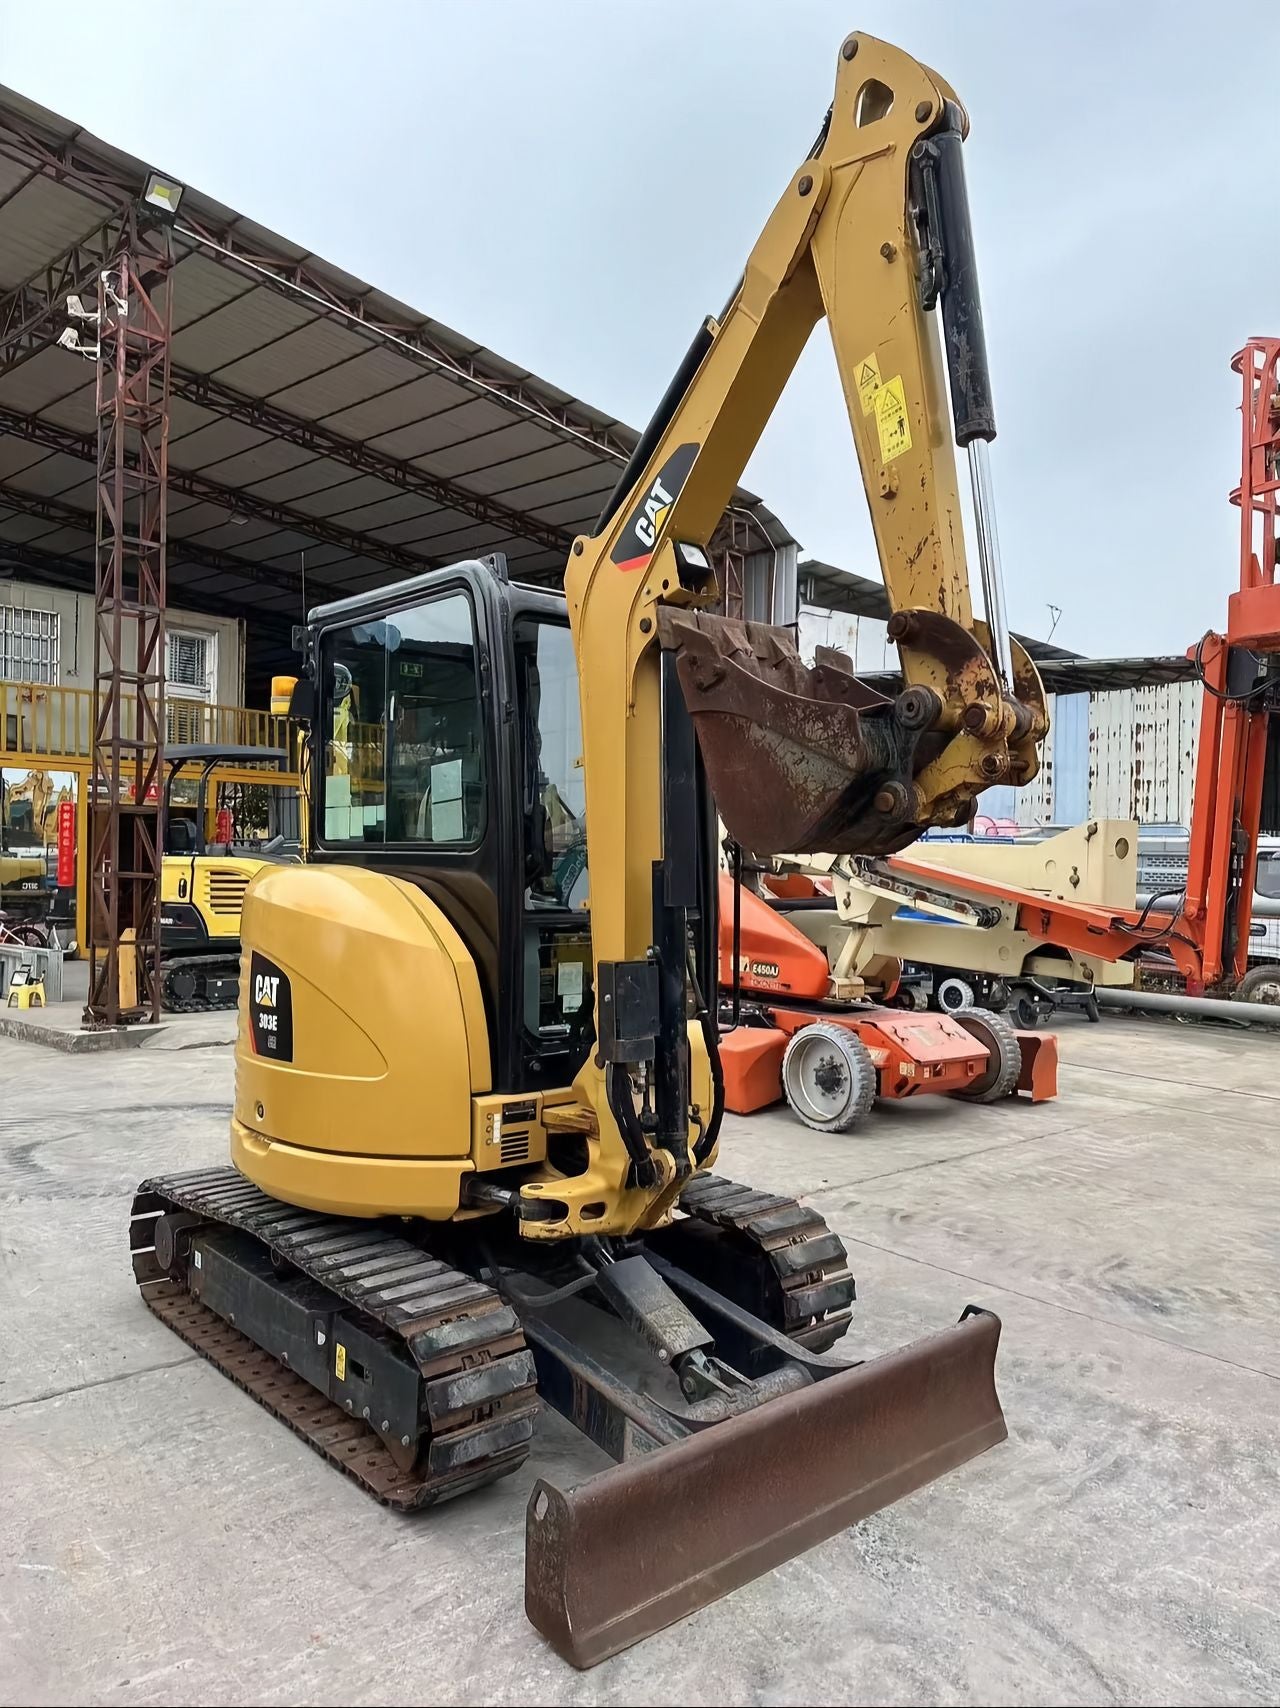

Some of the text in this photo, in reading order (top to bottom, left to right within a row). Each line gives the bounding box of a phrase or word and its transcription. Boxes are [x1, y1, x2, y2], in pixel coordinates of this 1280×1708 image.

[635, 476, 673, 547] CAT
[255, 974, 279, 1007] CAT
[259, 1013, 277, 1031] 303E
